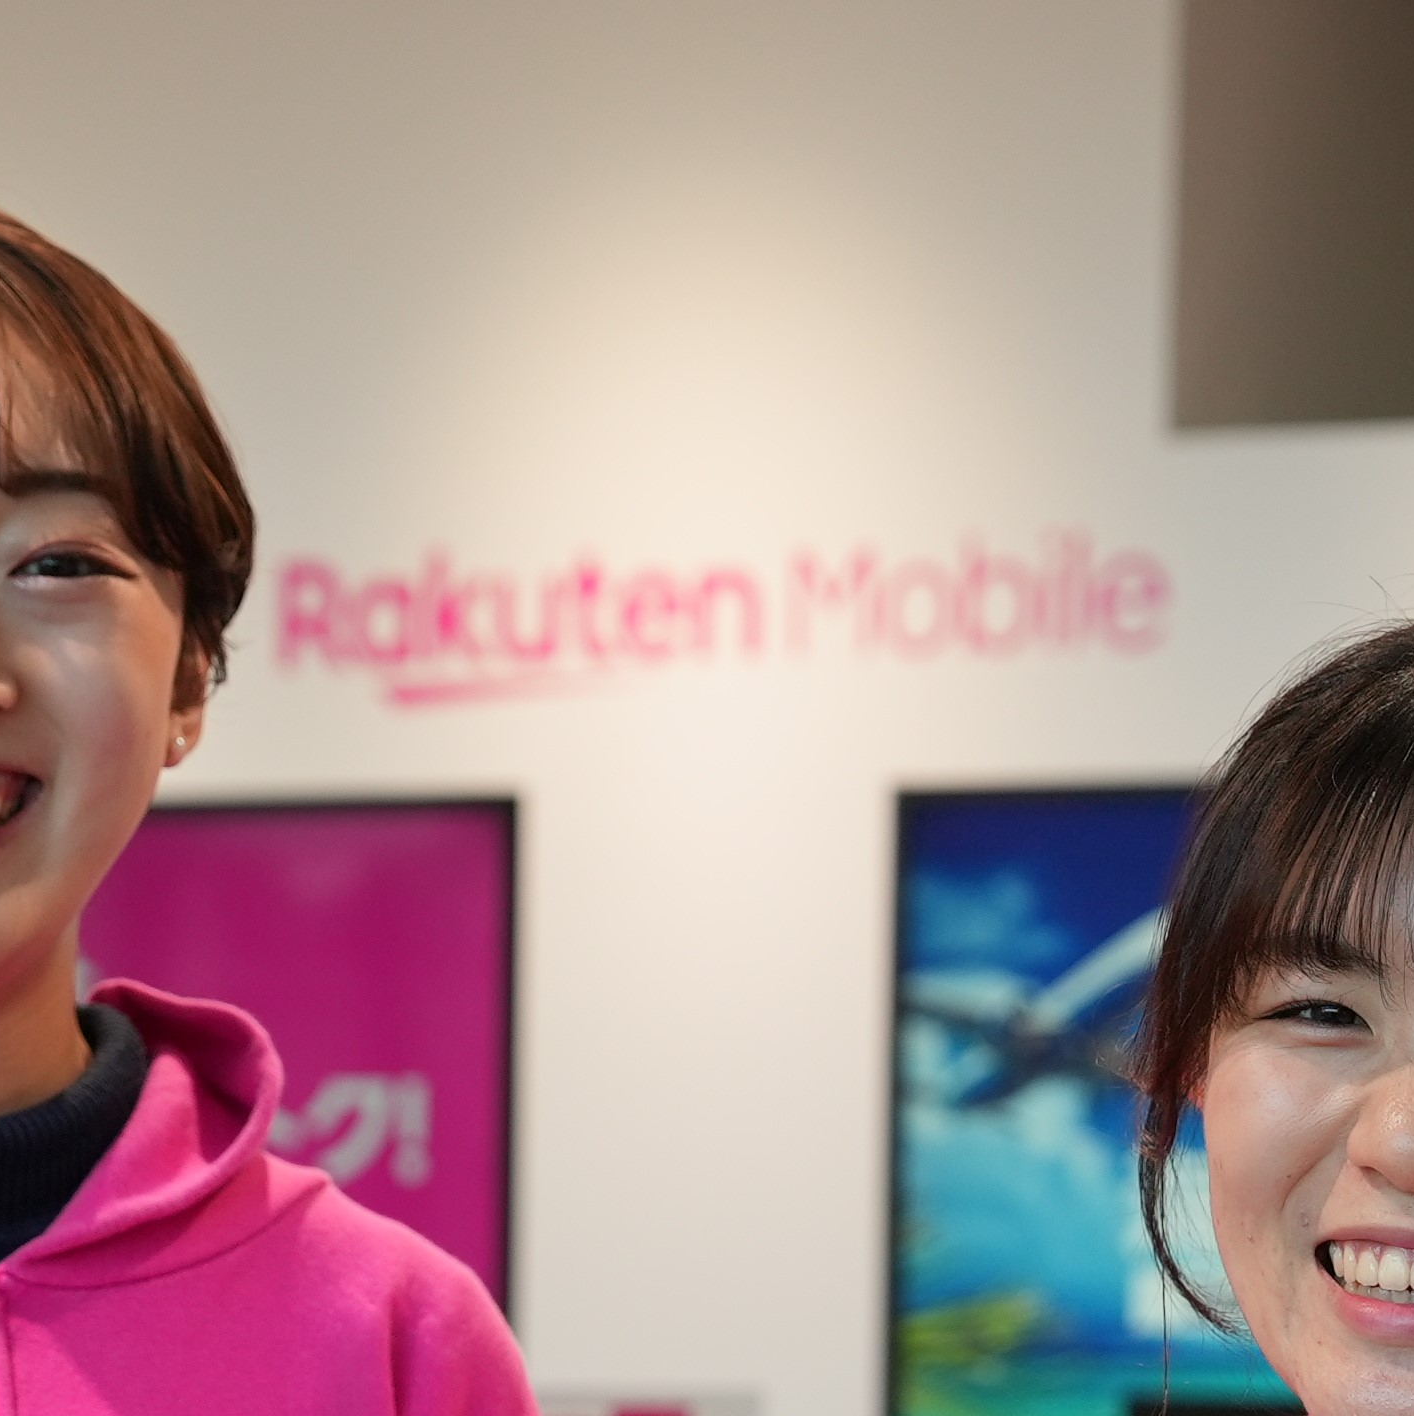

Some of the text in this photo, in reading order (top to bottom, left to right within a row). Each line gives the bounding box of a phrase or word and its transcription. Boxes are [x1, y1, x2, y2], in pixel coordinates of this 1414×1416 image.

[275, 526, 1175, 672] Rakuten Mobile
[272, 1072, 433, 1186] ク!
